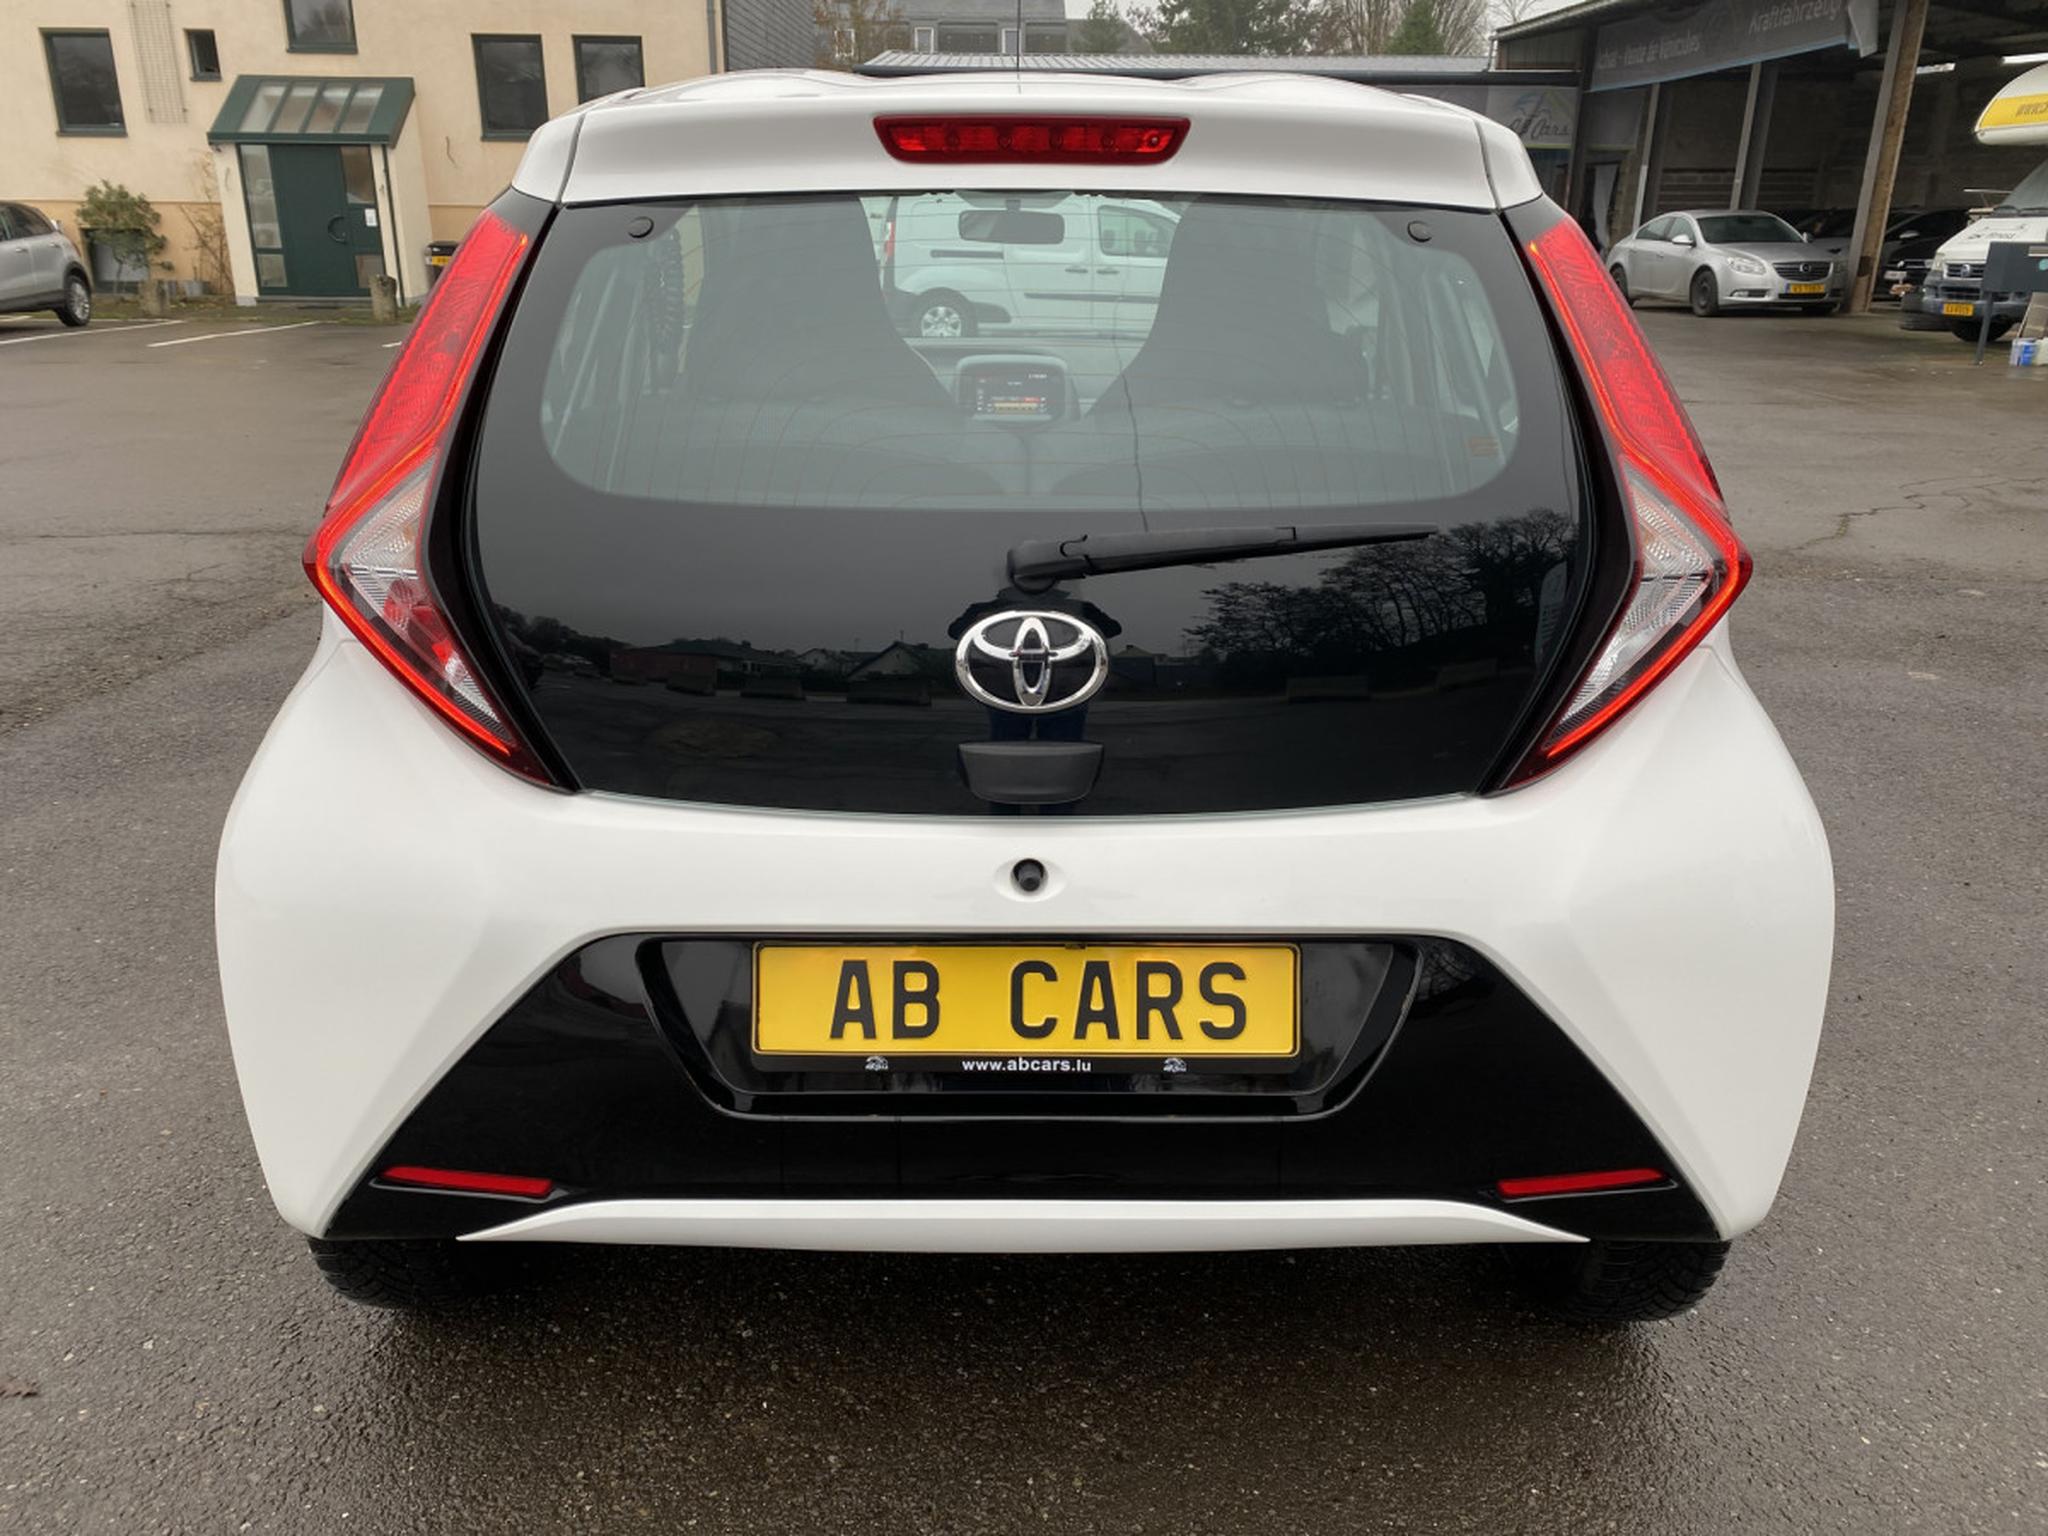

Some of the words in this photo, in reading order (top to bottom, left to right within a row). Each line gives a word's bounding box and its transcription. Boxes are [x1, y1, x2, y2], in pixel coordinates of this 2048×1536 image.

[829, 959, 941, 1041] AB
[1009, 959, 1248, 1041] CARS
[961, 1056, 1093, 1073] www.abcars.lu
